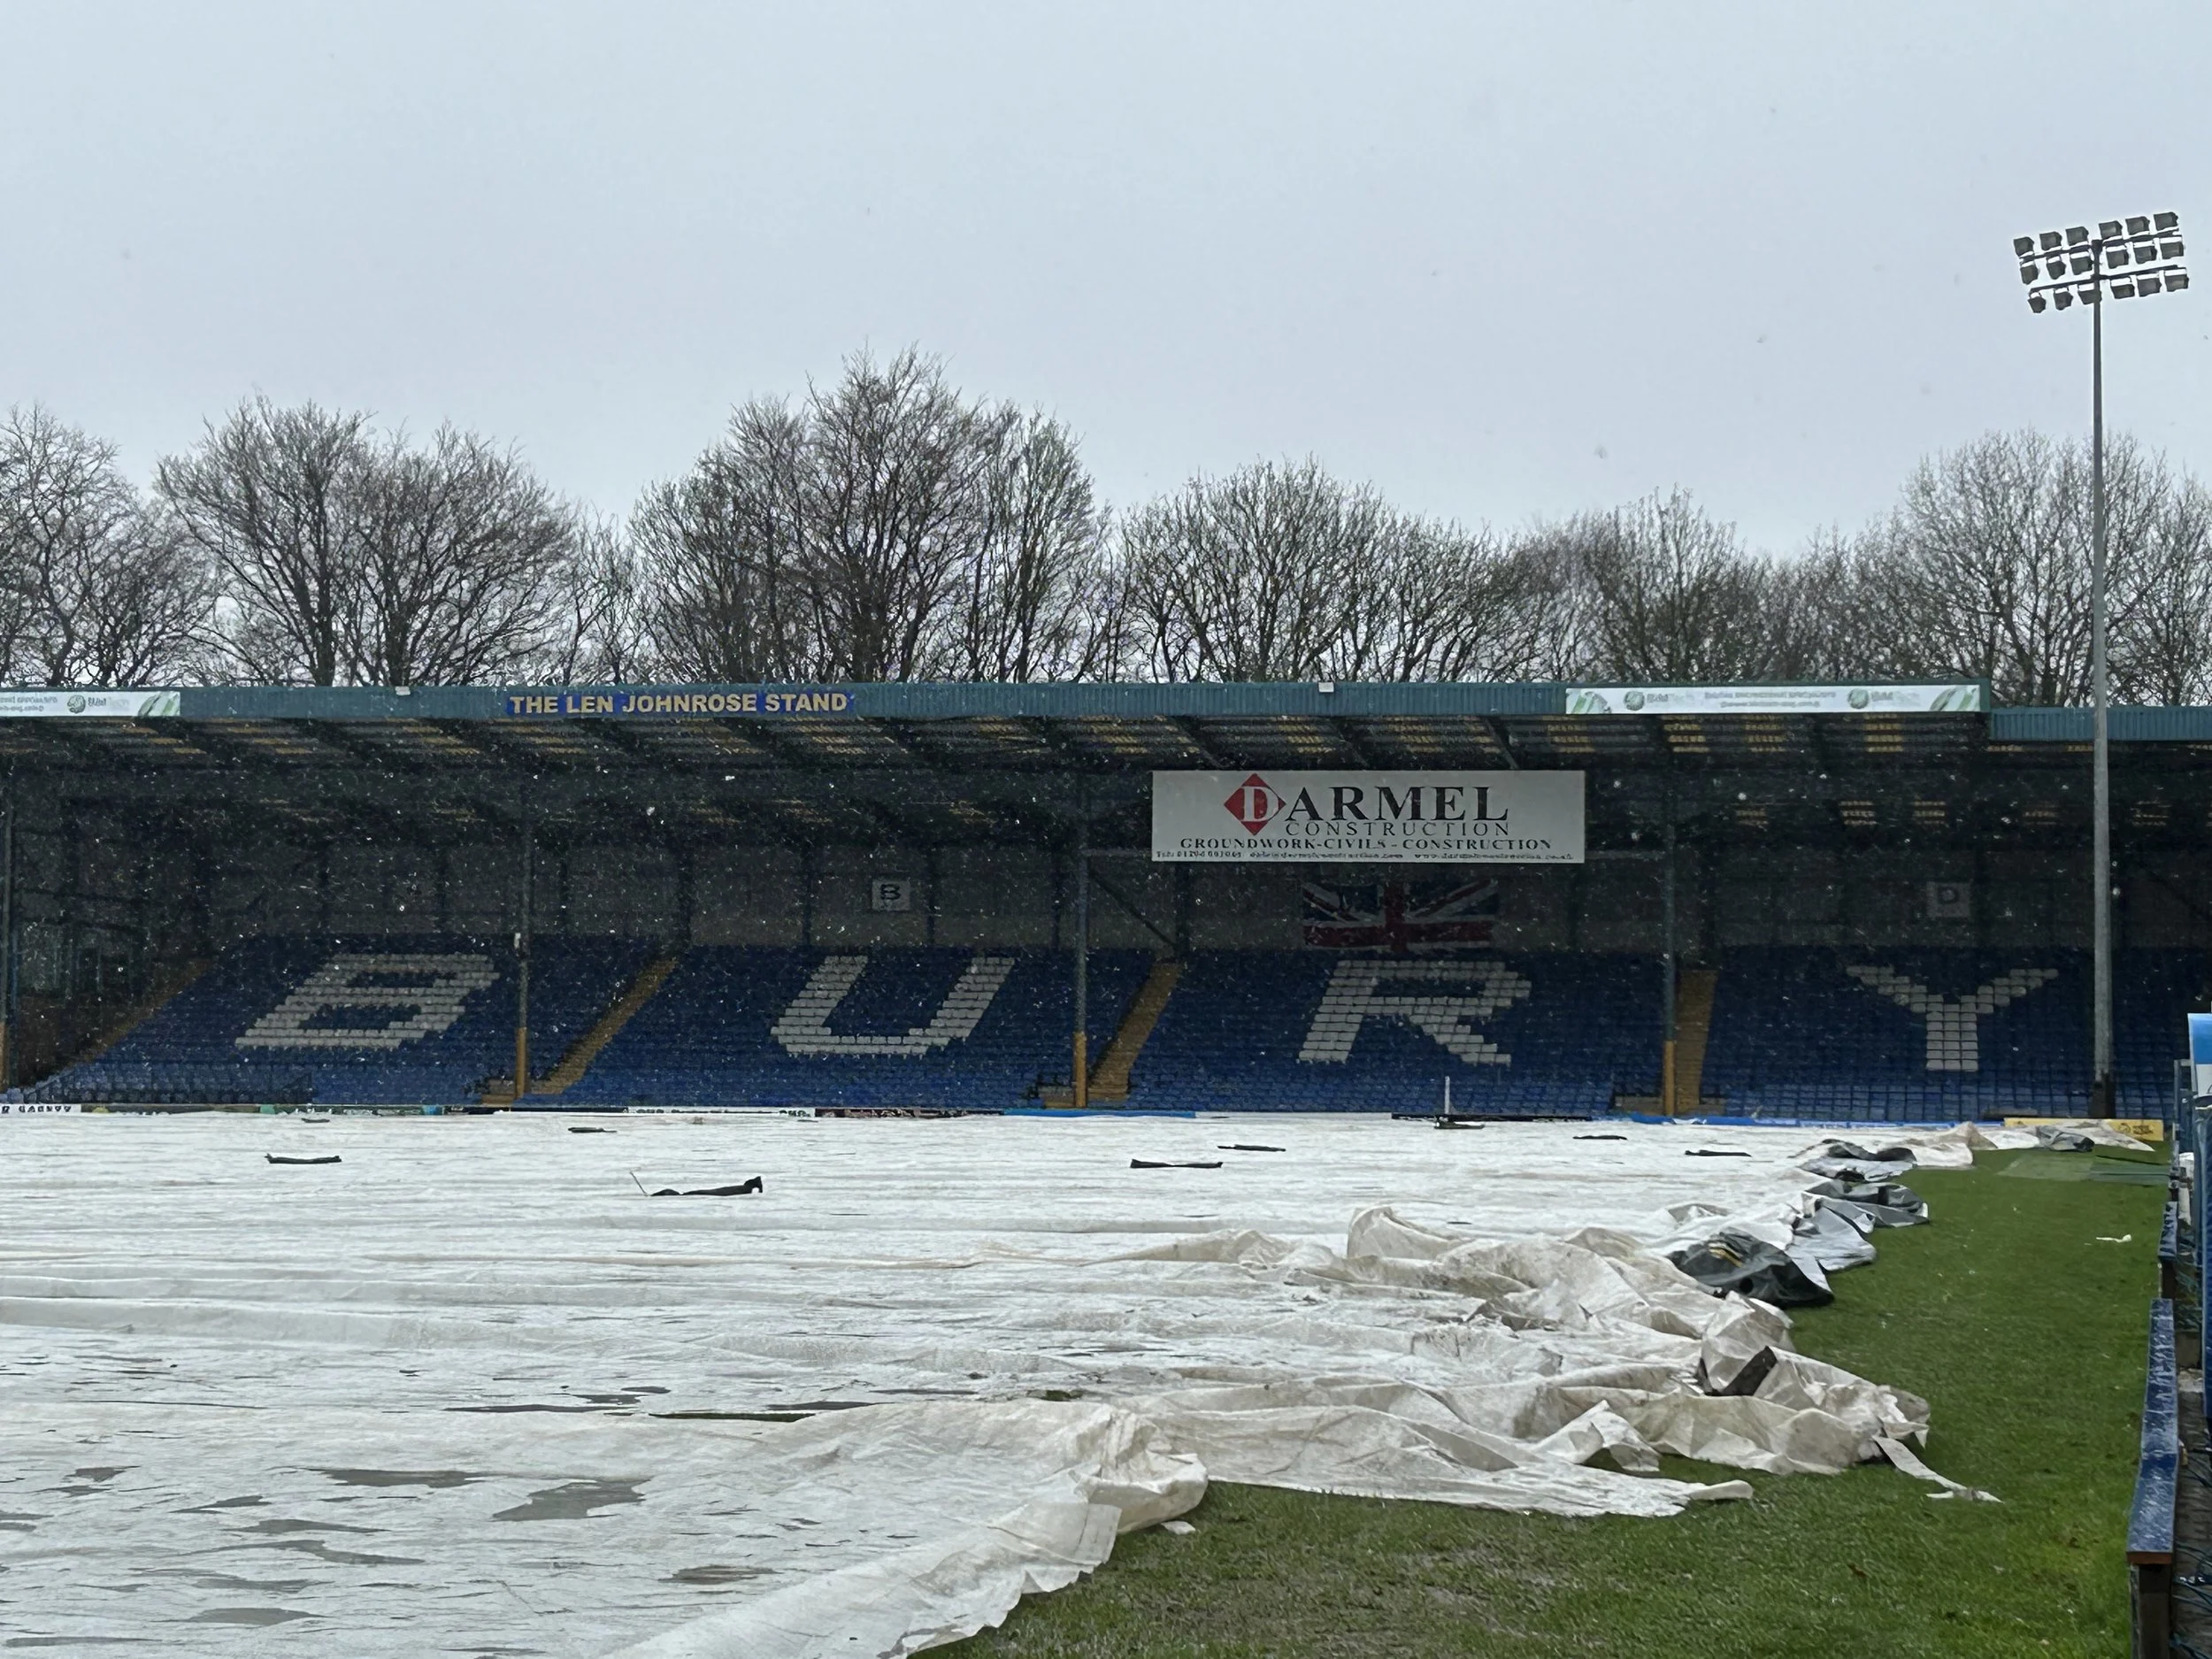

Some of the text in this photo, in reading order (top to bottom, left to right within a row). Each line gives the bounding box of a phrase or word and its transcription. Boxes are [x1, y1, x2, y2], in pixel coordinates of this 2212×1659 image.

[510, 693, 848, 713] THE LEN JOHNROSE STAND
[1240, 786, 1509, 822] DARMEL
[1286, 822, 1509, 836] CONSTRUCTION
[1402, 839, 1551, 850] CONSTRUCTION
[880, 883, 902, 900] B
